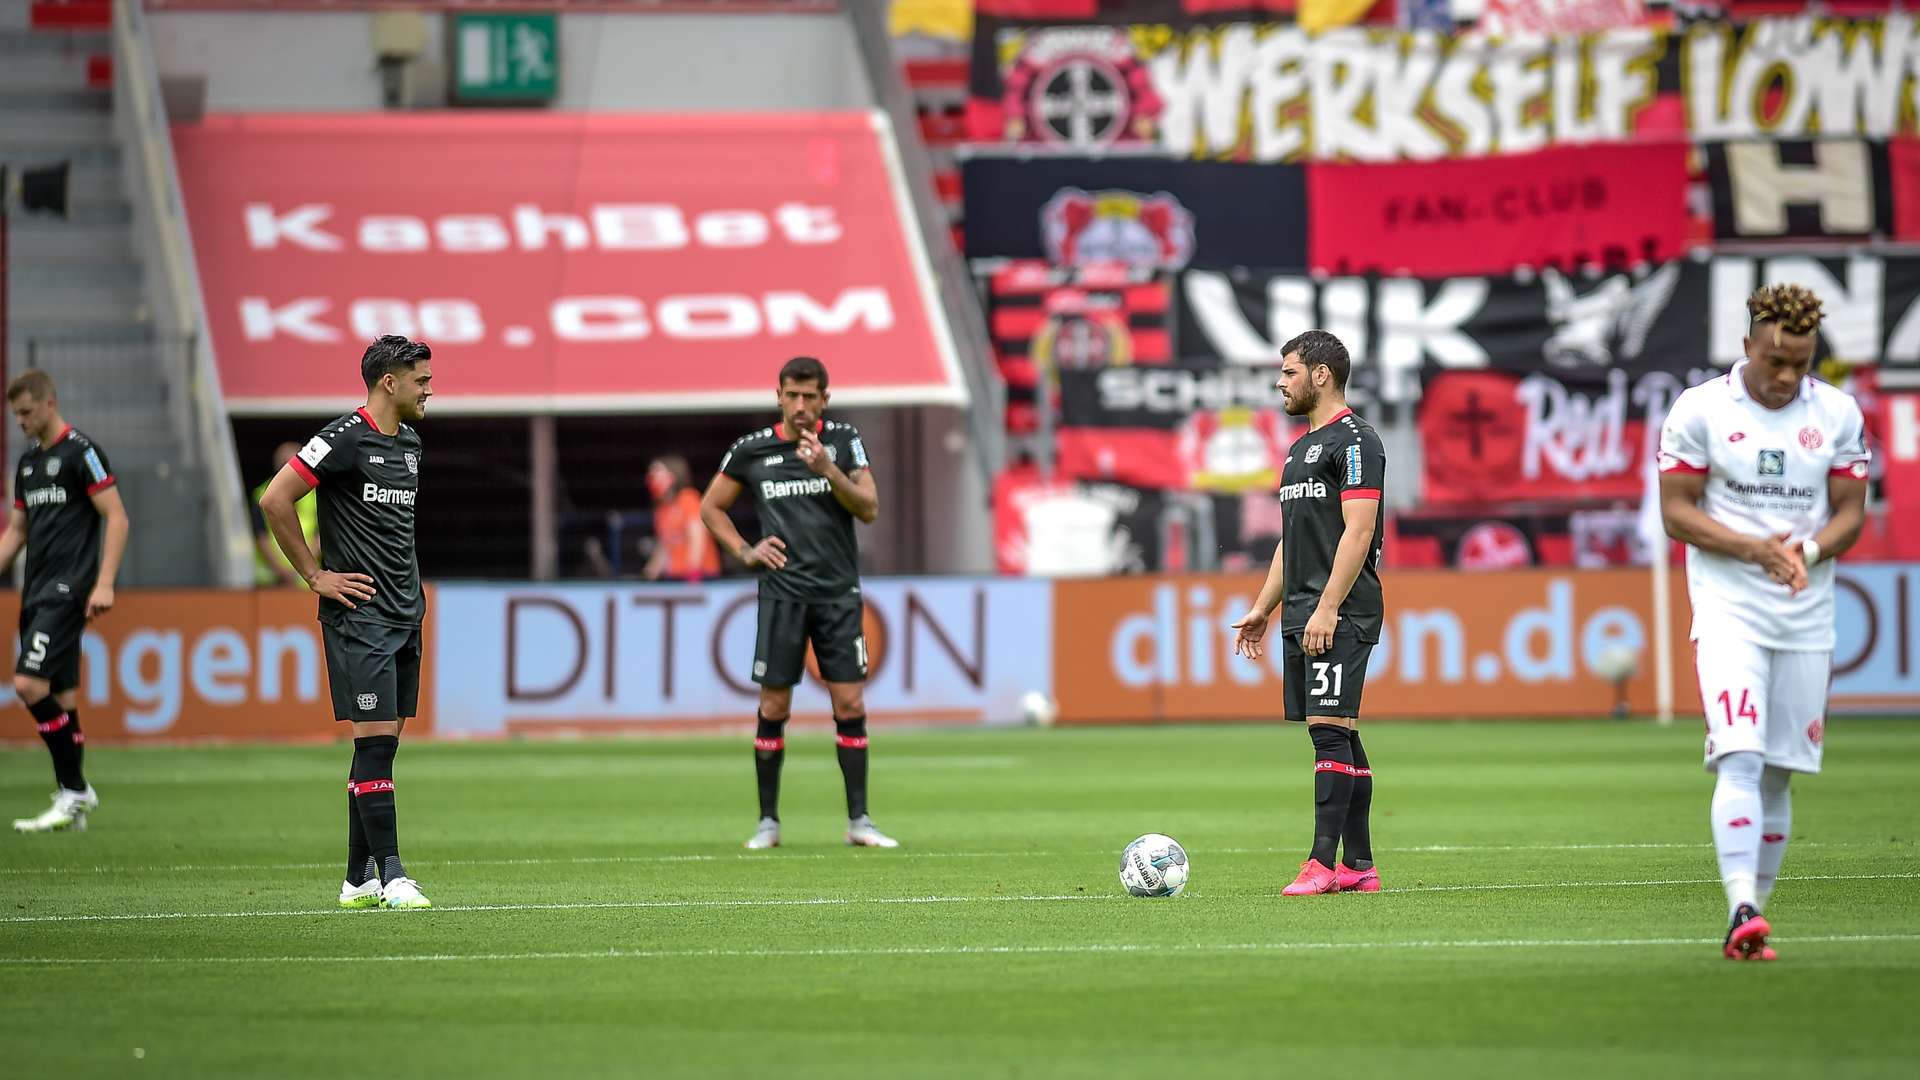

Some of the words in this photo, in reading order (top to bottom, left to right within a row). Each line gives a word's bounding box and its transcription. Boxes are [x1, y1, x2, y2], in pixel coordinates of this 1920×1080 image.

[1152, 21, 1662, 162] WERKSELF
[1688, 8, 1920, 143] LÖW
[245, 203, 842, 253] KashBet
[27, 631, 50, 662] 5
[1310, 662, 1343, 696] 31
[1319, 698, 1339, 706] JAKO
[1718, 687, 1758, 727] 14
